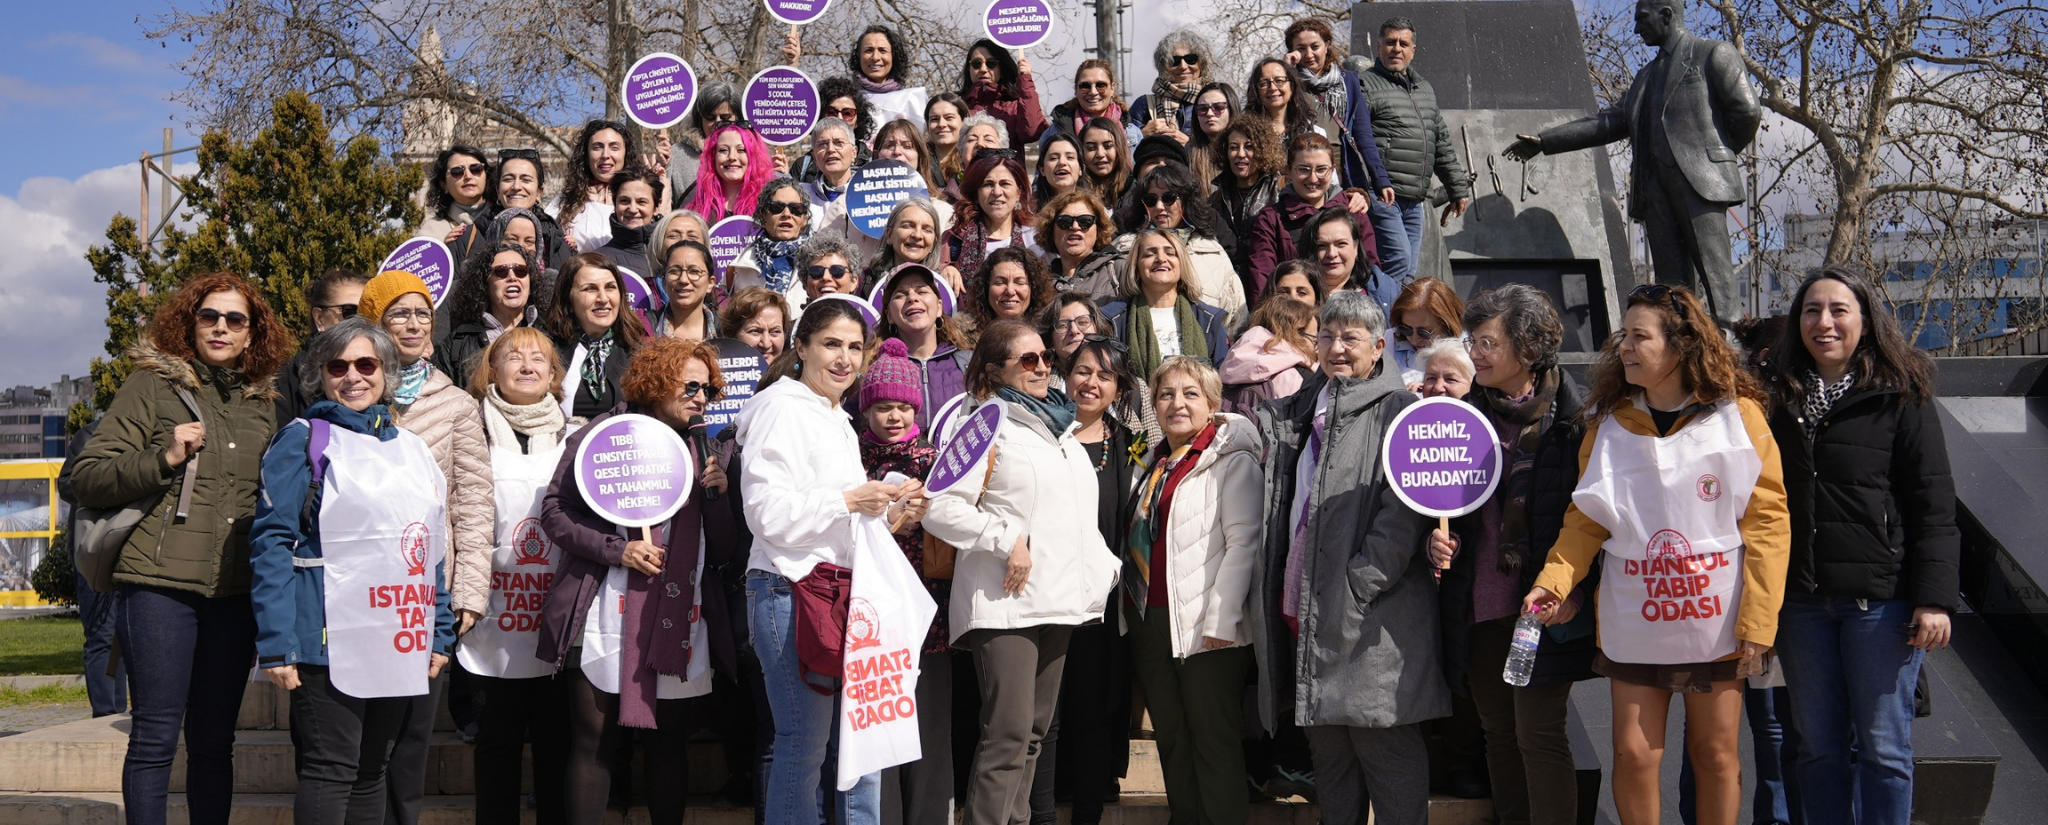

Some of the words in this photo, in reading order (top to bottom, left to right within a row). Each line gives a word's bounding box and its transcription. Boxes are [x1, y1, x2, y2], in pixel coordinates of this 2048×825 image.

[780, 2, 812, 12] HAKKIDIR!
[988, 17, 1012, 26] ERGEN
[1012, 14, 1050, 24] SAĞLIĞINA
[998, 24, 1042, 34] ZARARLIDIR!
[648, 64, 680, 78] CİNSİYETÇİ
[642, 78, 664, 90] SÖYLEM
[635, 84, 684, 101] UYGULAMALARA
[772, 90, 793, 98] ÇOCUK,
[636, 92, 686, 110] TAHAMMÜLÜMÜZ
[754, 99, 786, 107] YENİDOĞAN
[765, 108, 786, 116] KÜRTAJ
[784, 118, 807, 126] DOĞUM,
[862, 168, 892, 178] BAŞKA
[893, 166, 908, 176] BİR
[854, 180, 884, 192] SAĞLIK
[864, 192, 894, 203] BAŞKA
[895, 190, 910, 200] BİR
[851, 204, 892, 217] HEKİMLİK
[710, 234, 742, 245] GÜVENLİ,
[703, 413, 728, 425] EDEN
[1408, 420, 1470, 441] HEKİMİZ,
[609, 434, 633, 446] TIBB
[1410, 446, 1472, 464] KADINIZ,
[594, 468, 621, 480] QESE
[1401, 470, 1487, 488] BURADAYIZ!
[599, 484, 615, 495] RA
[615, 479, 672, 494] TAHAMMUL
[616, 495, 661, 509] NÊKEME!
[1643, 574, 1710, 598] TABİP
[1641, 595, 1722, 622] ODASI
[498, 613, 543, 632] ODA
